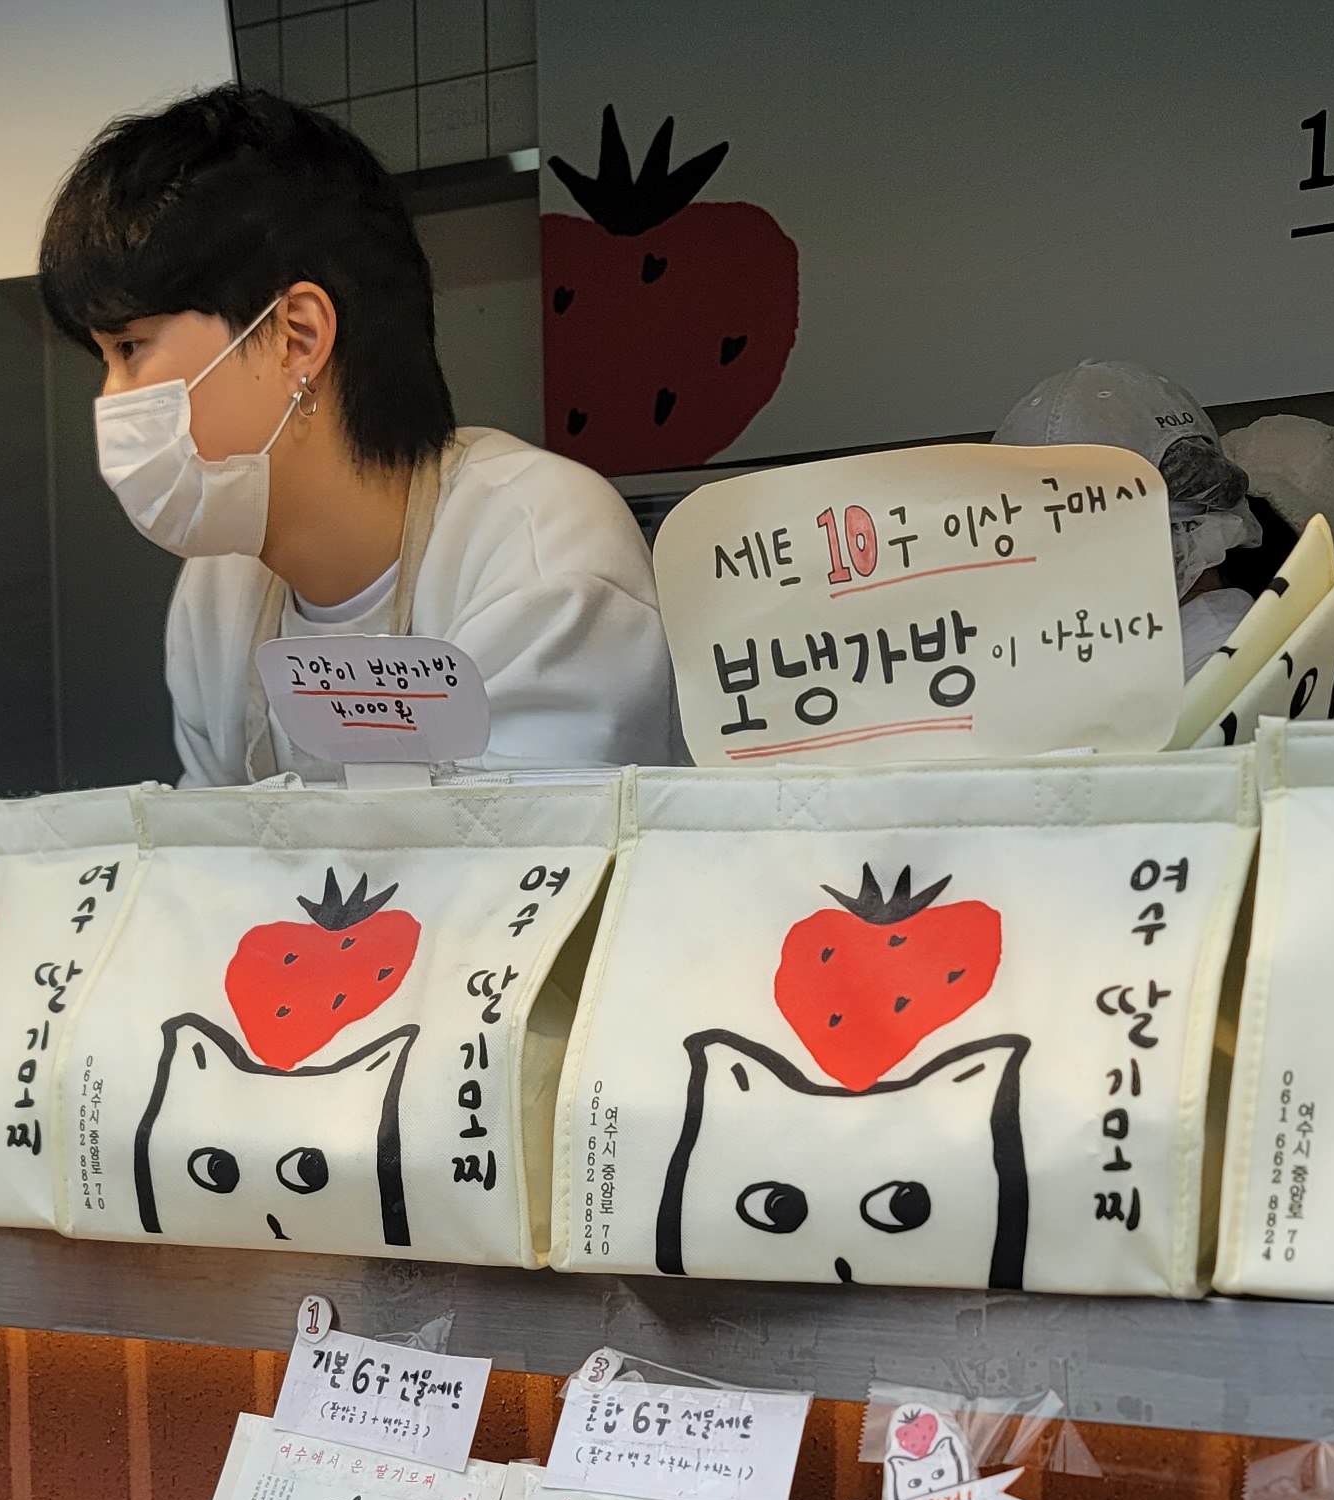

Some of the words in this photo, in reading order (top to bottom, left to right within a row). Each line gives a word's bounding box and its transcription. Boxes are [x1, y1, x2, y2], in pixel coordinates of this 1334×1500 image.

[1154, 410, 1195, 429] POLO
[713, 527, 802, 588] 세트
[815, 504, 923, 586] 10구
[943, 491, 1023, 559] 이상
[1041, 607, 1165, 665] 나옵니다
[286, 655, 356, 691] 고양이
[367, 655, 457, 690] 보냉가방
[82, 1055, 93, 1096] 061
[1279, 1070, 1293, 1123] 061
[89, 1079, 103, 1124] 여수시
[590, 1080, 603, 1126] 061
[602, 1106, 618, 1158] 여수시
[1292, 1101, 1315, 1159] 여수시
[586, 1136, 596, 1182] 662
[1271, 1133, 1286, 1184] 662
[80, 1155, 92, 1209] 8824
[95, 1183, 105, 1210] 70
[584, 1192, 593, 1255] 8824
[601, 1224, 610, 1256] 70
[1262, 1194, 1279, 1261] 8824
[1284, 1229, 1297, 1262] 70
[306, 1302, 320, 1335] 1
[312, 1350, 349, 1389] 기본
[352, 1358, 390, 1395] 6구
[590, 1357, 611, 1382] 3
[585, 1393, 624, 1434] 혼합
[632, 1401, 671, 1436] 6구
[681, 1409, 753, 1440] 선물세트
[279, 1443, 340, 1471] 여수에서
[351, 1457, 363, 1473] 온
[375, 1464, 436, 1489] 딸기모찌
